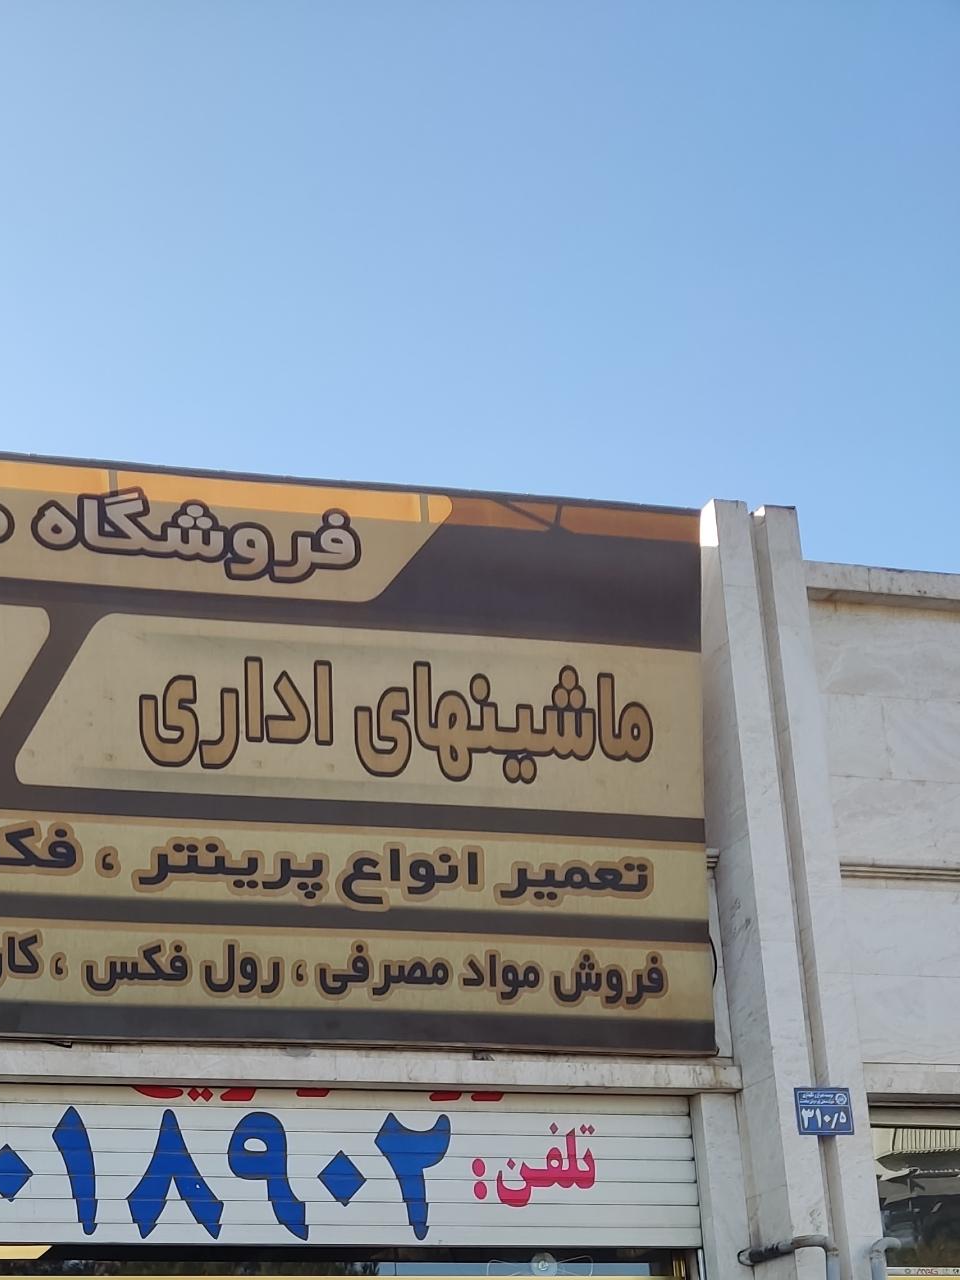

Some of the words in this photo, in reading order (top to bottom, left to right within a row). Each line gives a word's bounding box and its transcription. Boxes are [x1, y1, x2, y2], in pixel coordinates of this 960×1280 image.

[32, 487, 361, 583] فروشگاه
[139, 657, 333, 769] اداری
[355, 661, 653, 783] ماشینهای
[138, 842, 325, 899] پرینتر
[342, 847, 479, 906] انواع
[499, 861, 648, 901] تعمیر
[85, 944, 189, 992] فکس
[204, 944, 281, 993] رول
[319, 943, 451, 997] مصرفی
[462, 953, 540, 1000] مواد
[553, 954, 666, 1003] فروش
